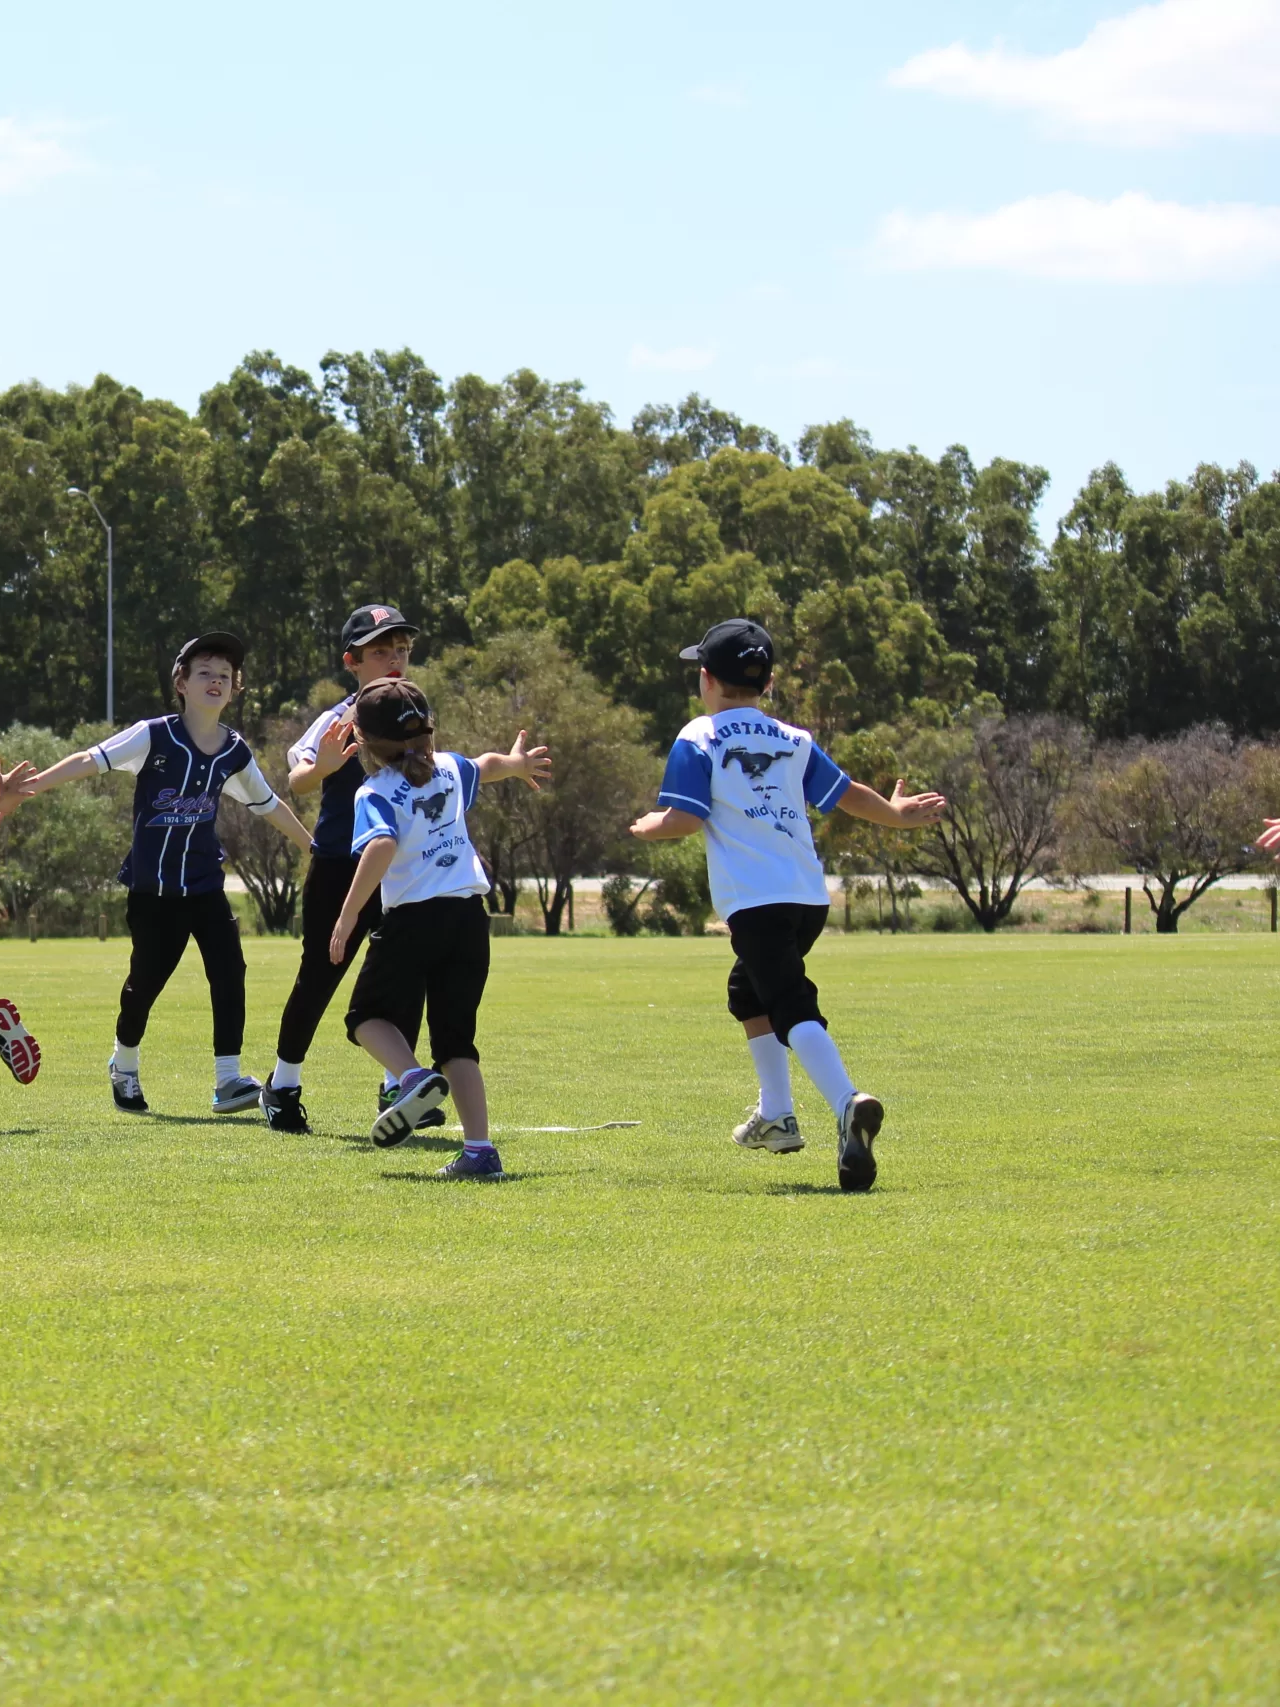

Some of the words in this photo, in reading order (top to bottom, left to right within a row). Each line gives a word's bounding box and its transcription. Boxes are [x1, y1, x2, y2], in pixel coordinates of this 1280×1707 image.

[390, 767, 454, 807] MUNGS
[184, 815, 200, 823] 2014
[744, 804, 778, 819] Midy
[780, 807, 802, 819] Fo
[422, 838, 453, 861] Mway
[454, 835, 466, 846] Frd
